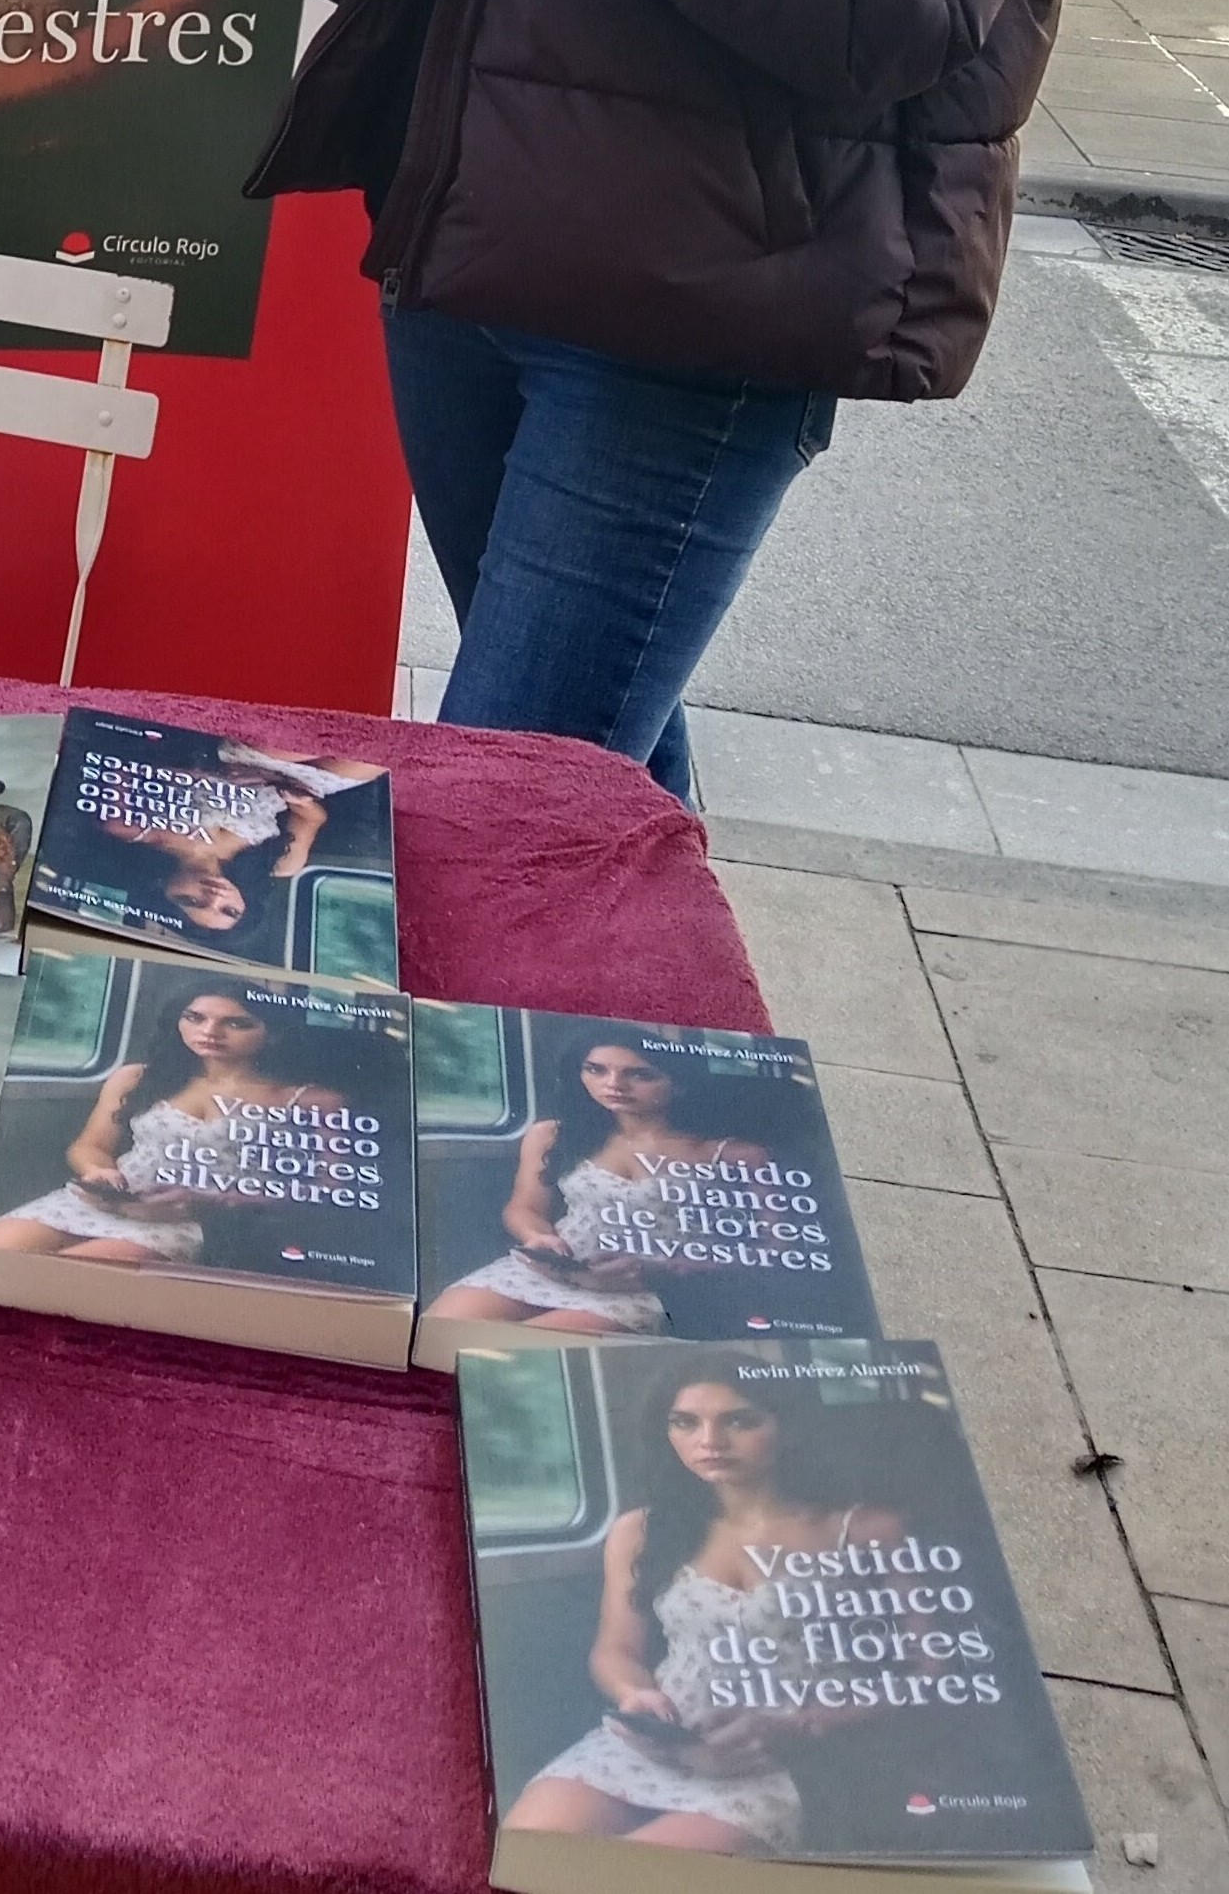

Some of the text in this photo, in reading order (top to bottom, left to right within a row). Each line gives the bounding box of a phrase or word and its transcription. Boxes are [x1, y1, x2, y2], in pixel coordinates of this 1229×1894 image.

[103, 235, 219, 260] Círculo Rojo
[81, 766, 252, 816] de flores
[85, 751, 257, 800] silvestres
[76, 798, 213, 845] Vestido
[79, 783, 201, 826] blanco
[246, 989, 287, 1006] Kevin
[642, 1038, 794, 1064] Kevin Pérez Alarcón
[212, 1094, 380, 1133] Vestido
[228, 1118, 380, 1157] blanco
[164, 1138, 383, 1186] de flores
[634, 1151, 812, 1189] Vestido
[156, 1163, 380, 1211] silvestres
[659, 1178, 818, 1215] blanco
[600, 1202, 830, 1247] de flores
[599, 1228, 832, 1272] silvestres
[737, 1361, 922, 1380] Kevin Pérez Alarcón
[743, 1536, 962, 1578] Vestido
[775, 1580, 974, 1619] blanco
[708, 1620, 994, 1667] de flores
[709, 1668, 1001, 1708] silvestres
[993, 1794, 1027, 1810] Rojo
